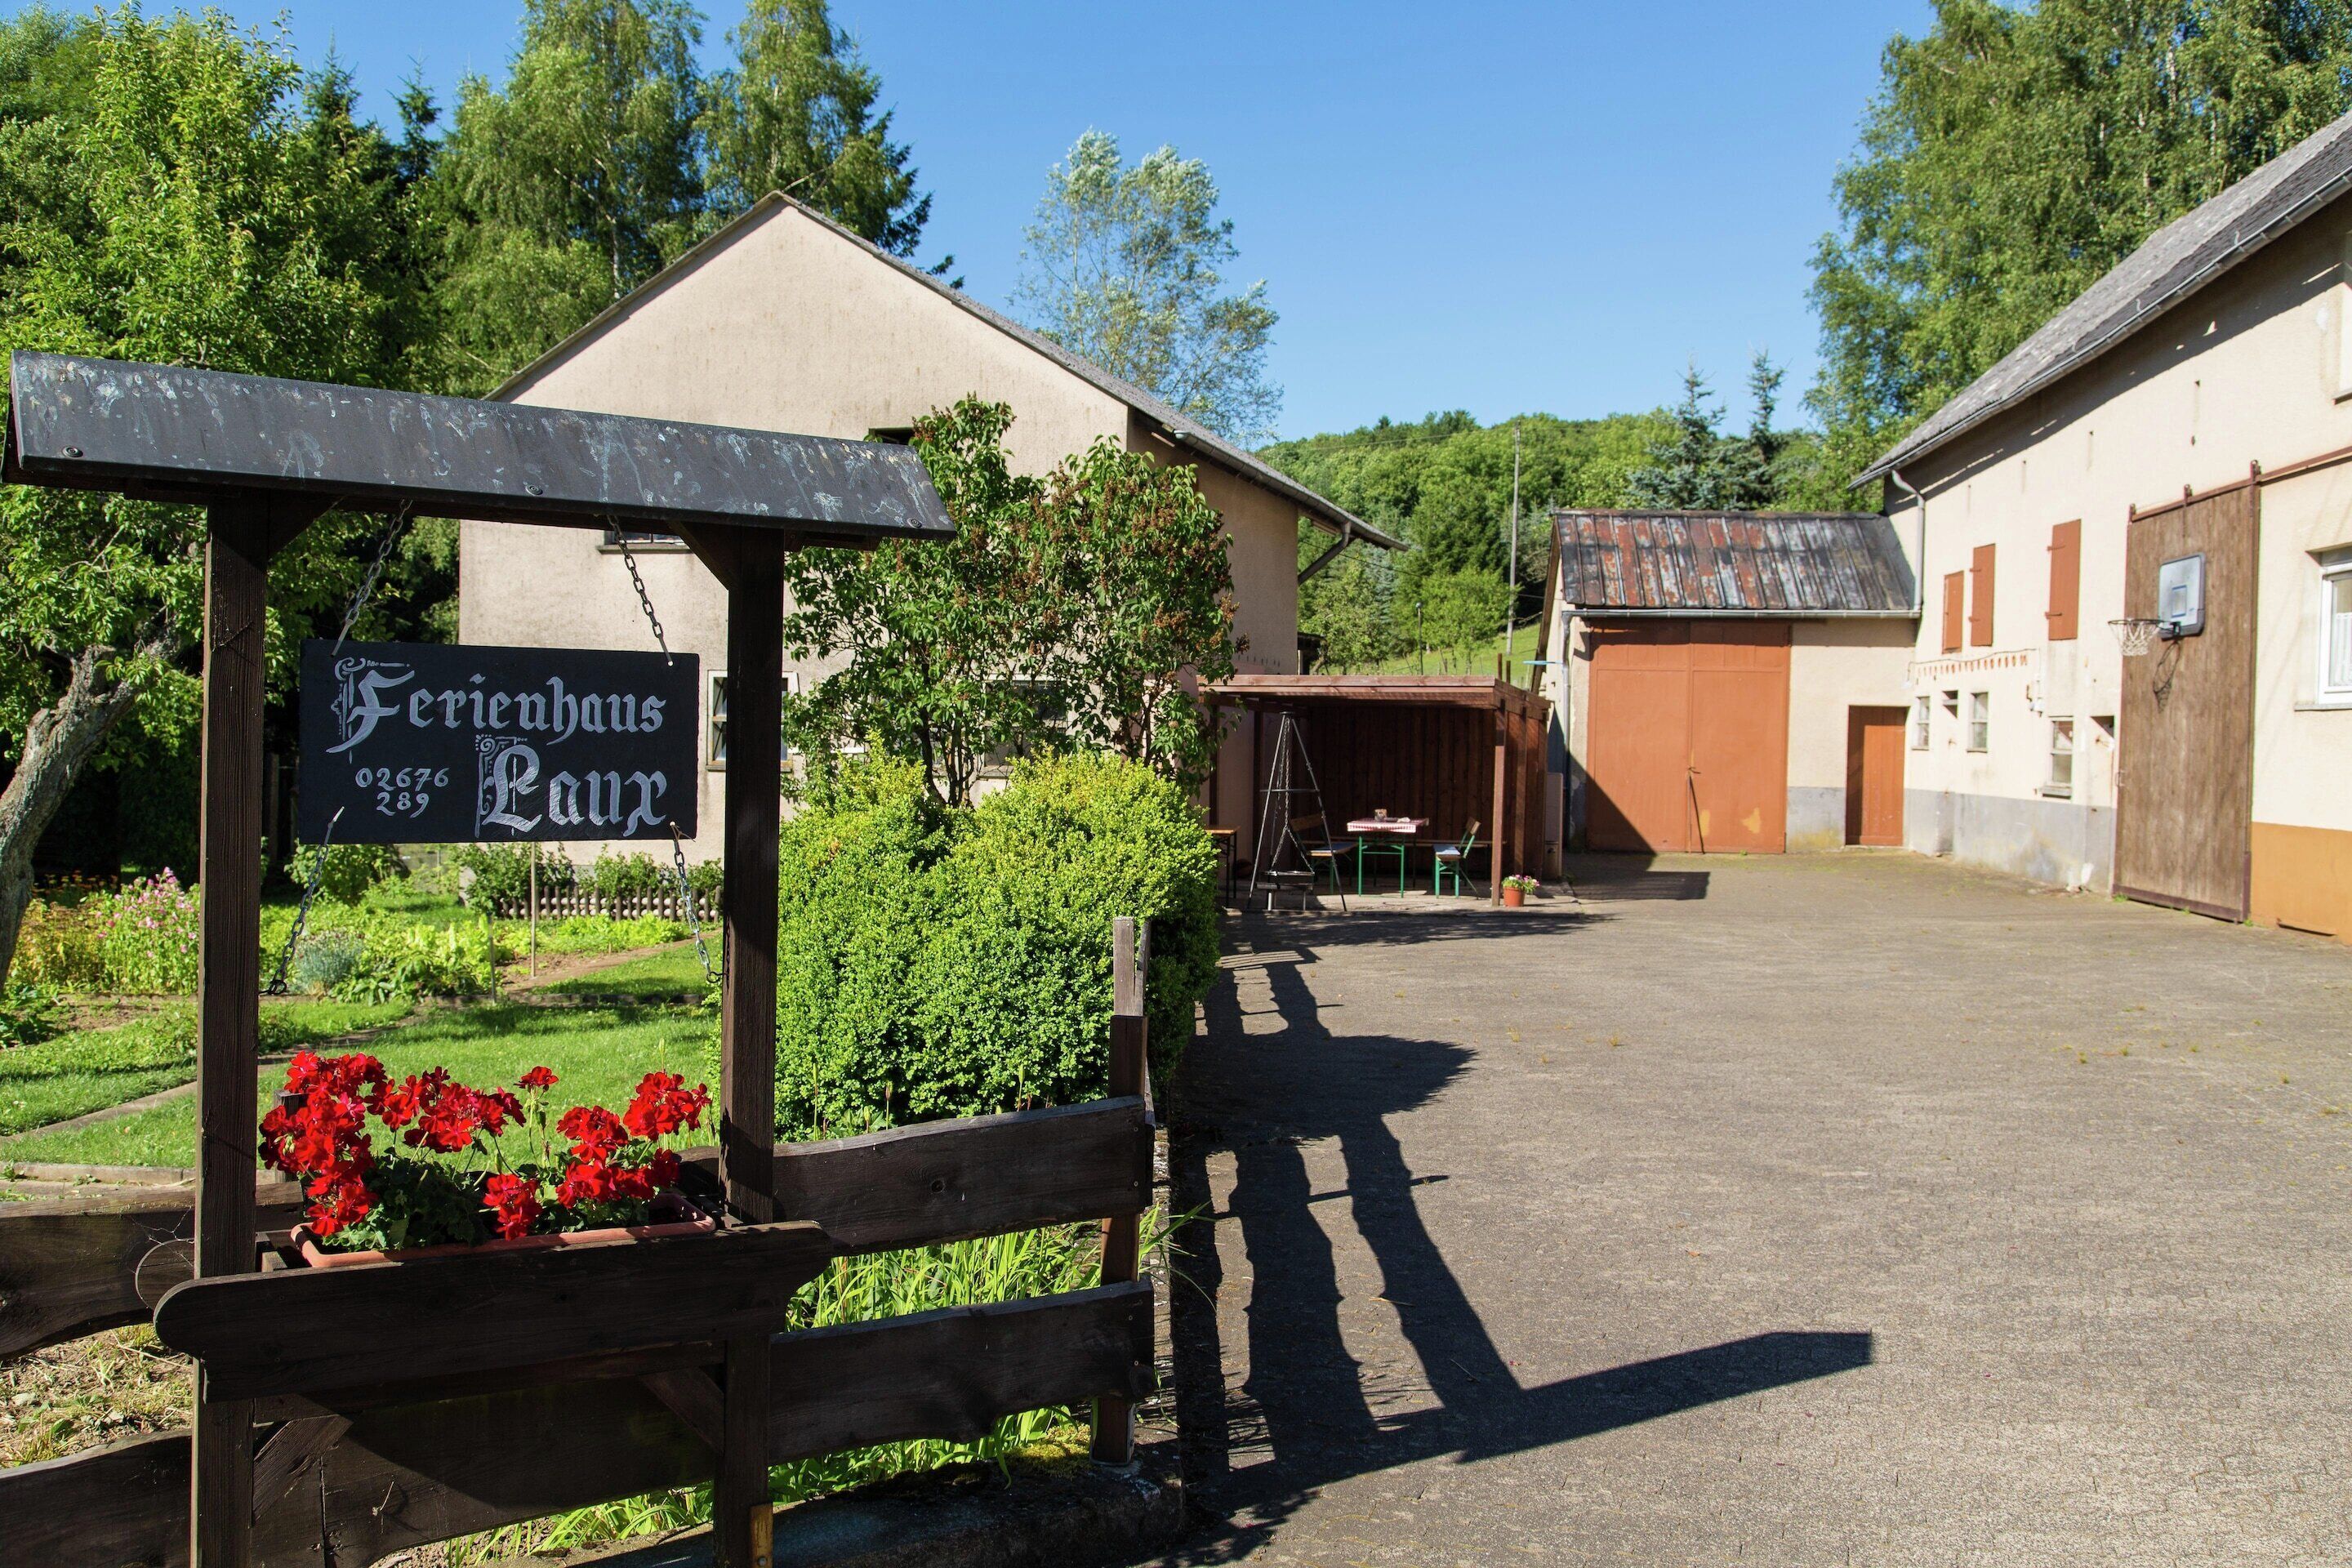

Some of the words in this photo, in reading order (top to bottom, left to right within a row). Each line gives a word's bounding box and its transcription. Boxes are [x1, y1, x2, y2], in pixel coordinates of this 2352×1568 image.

[326, 657, 667, 762] Ferienhaus
[354, 767, 449, 792] 02676
[376, 791, 430, 817] 289
